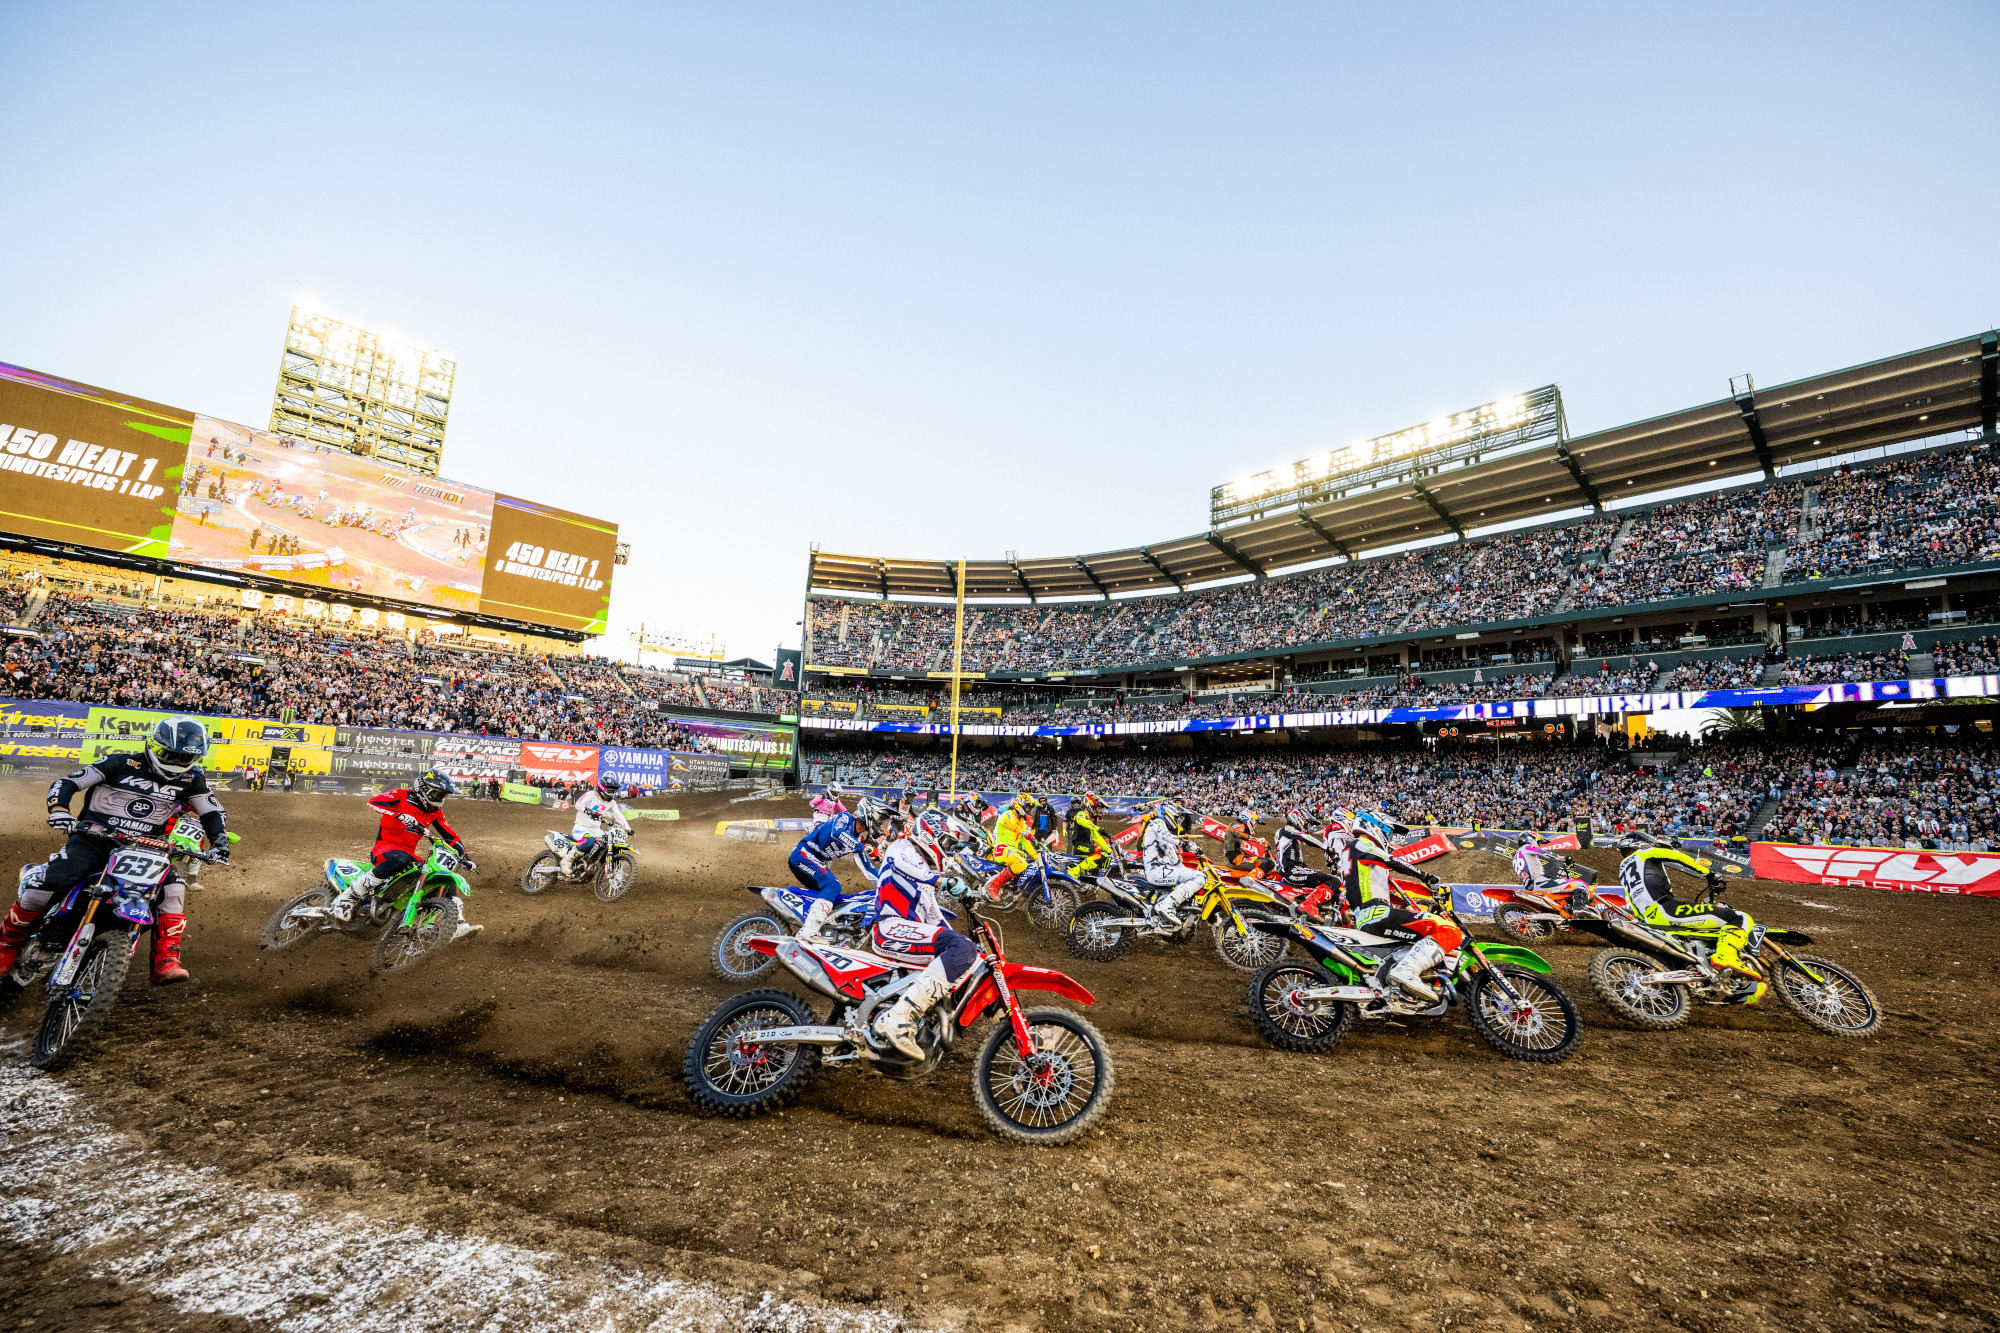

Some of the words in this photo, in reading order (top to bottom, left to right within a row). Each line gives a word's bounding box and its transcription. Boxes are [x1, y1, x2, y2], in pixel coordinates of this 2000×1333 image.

[56, 439, 139, 477] HEAT
[138, 458, 159, 482] 1
[0, 453, 118, 490] INUTES/PLUS
[119, 480, 131, 493] 1
[129, 482, 164, 499] LAP
[505, 541, 545, 566] 450
[544, 549, 588, 575] HEAT
[588, 560, 599, 578] 1
[504, 561, 578, 586] MINUTES/PLUS
[578, 577, 585, 587] 1
[583, 578, 603, 591] LAP
[264, 727, 300, 739] SMX
[525, 746, 597, 760] FLY
[619, 752, 663, 766] YAMAHA
[706, 760, 728, 768] SPORTS
[617, 772, 662, 786] YAMAHA
[509, 789, 538, 798] Kawasaki
[638, 811, 669, 819] Kawasaki
[119, 819, 153, 832] YAMAHA
[175, 823, 205, 842] 976
[839, 833, 857, 849] YAMAHA
[1715, 849, 1736, 860] 5.11
[111, 855, 169, 878] 637
[1772, 847, 2000, 884] FLY
[1822, 877, 1960, 893] RACING
[782, 893, 805, 908] 64
[1675, 904, 1714, 916] FXR
[874, 946, 898, 957] HONDA
